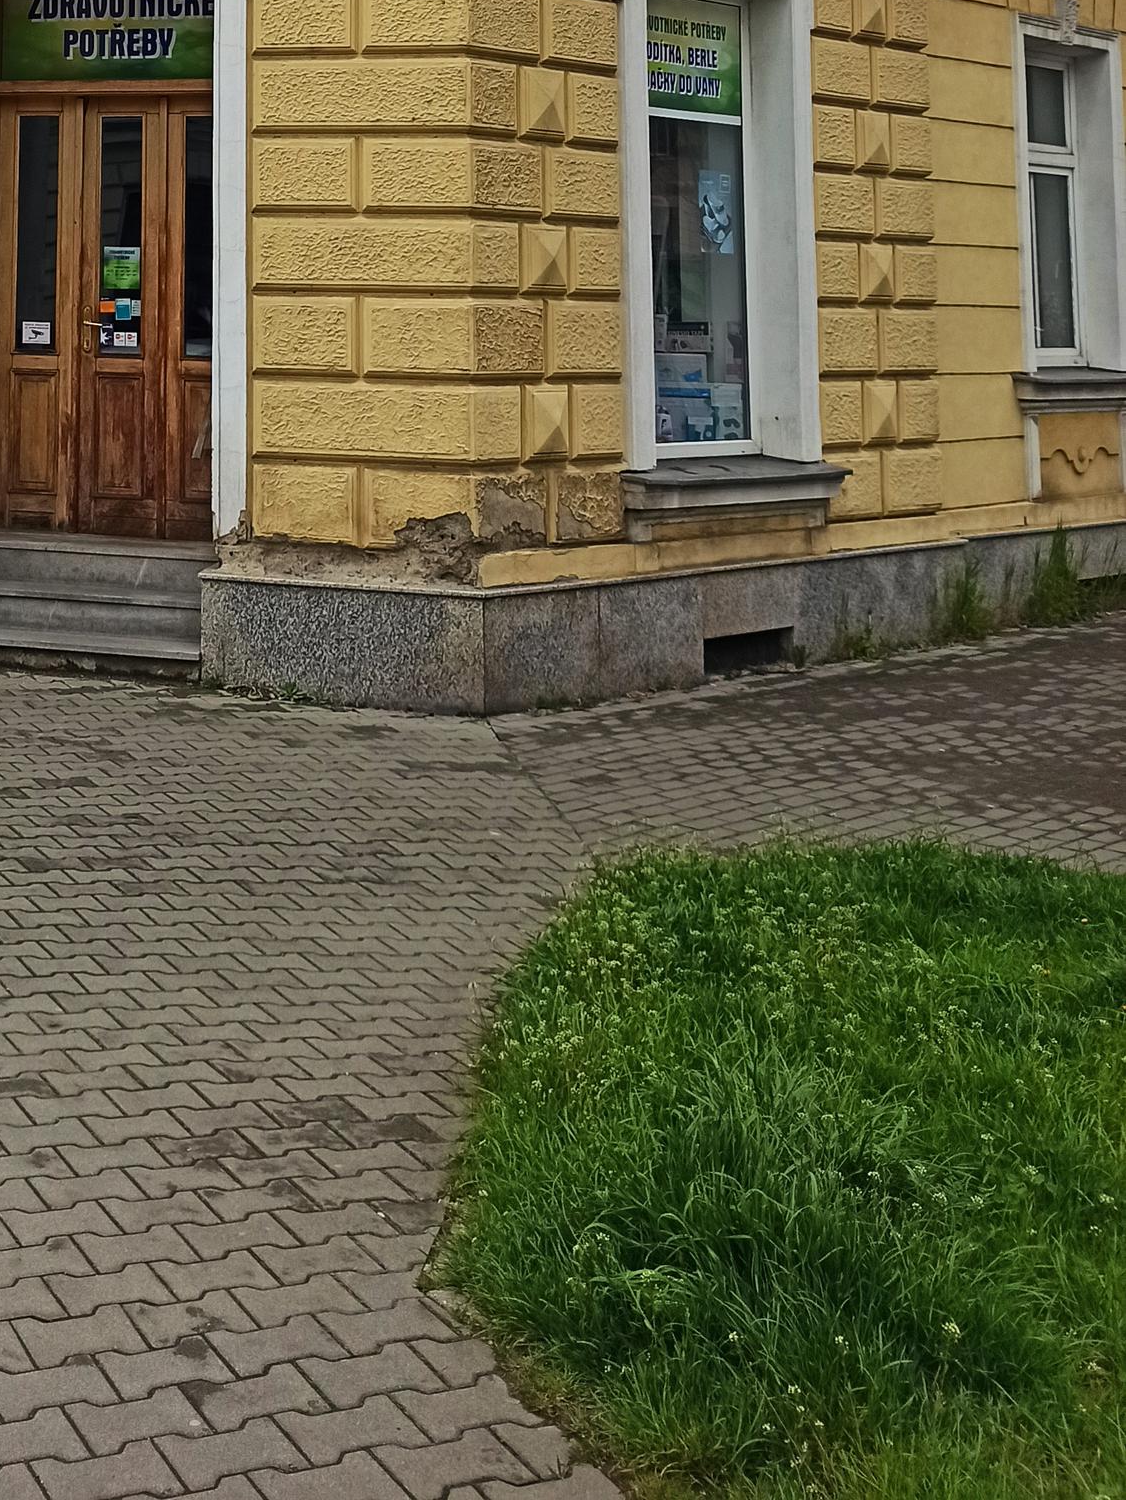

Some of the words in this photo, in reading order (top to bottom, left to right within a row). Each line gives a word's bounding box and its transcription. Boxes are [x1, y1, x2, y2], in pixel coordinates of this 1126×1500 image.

[62, 22, 175, 60] POTŘEBY
[647, 14, 688, 36] VOTNICKÉ
[691, 21, 726, 41] POTŘEBY
[688, 47, 718, 70] BERLE
[647, 68, 676, 93] AČKY
[678, 74, 693, 95] DO
[695, 75, 721, 98] VANY
